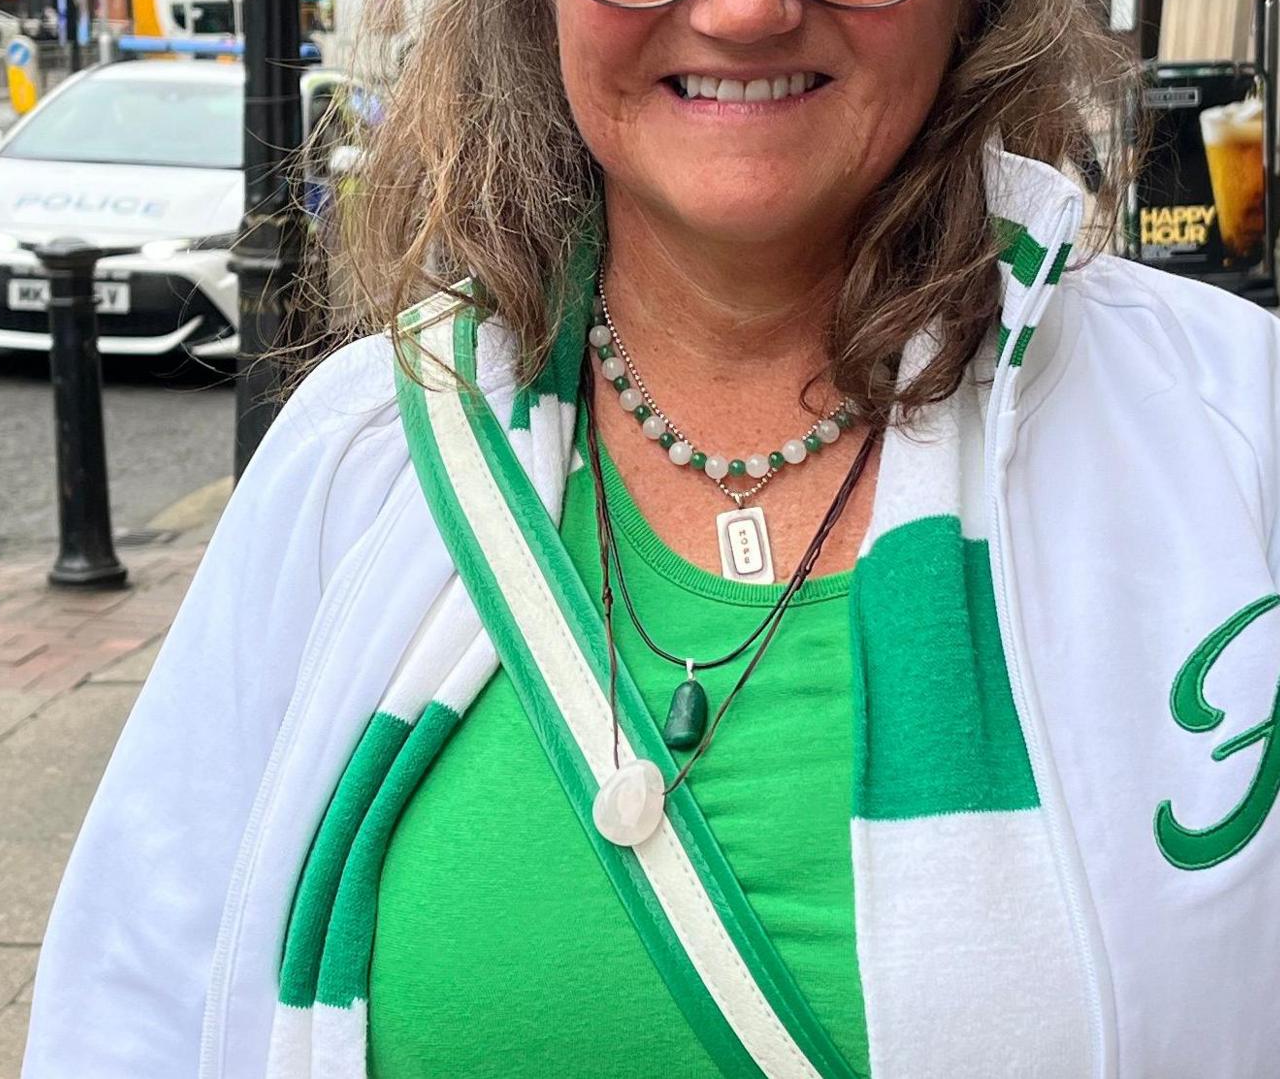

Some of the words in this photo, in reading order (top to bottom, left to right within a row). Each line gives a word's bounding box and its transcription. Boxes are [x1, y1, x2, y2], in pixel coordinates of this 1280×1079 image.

[14, 191, 170, 218] POLICE
[1140, 206, 1215, 224] HAPPY
[1140, 224, 1208, 245] HOUR
[739, 529, 750, 564] HOPE
